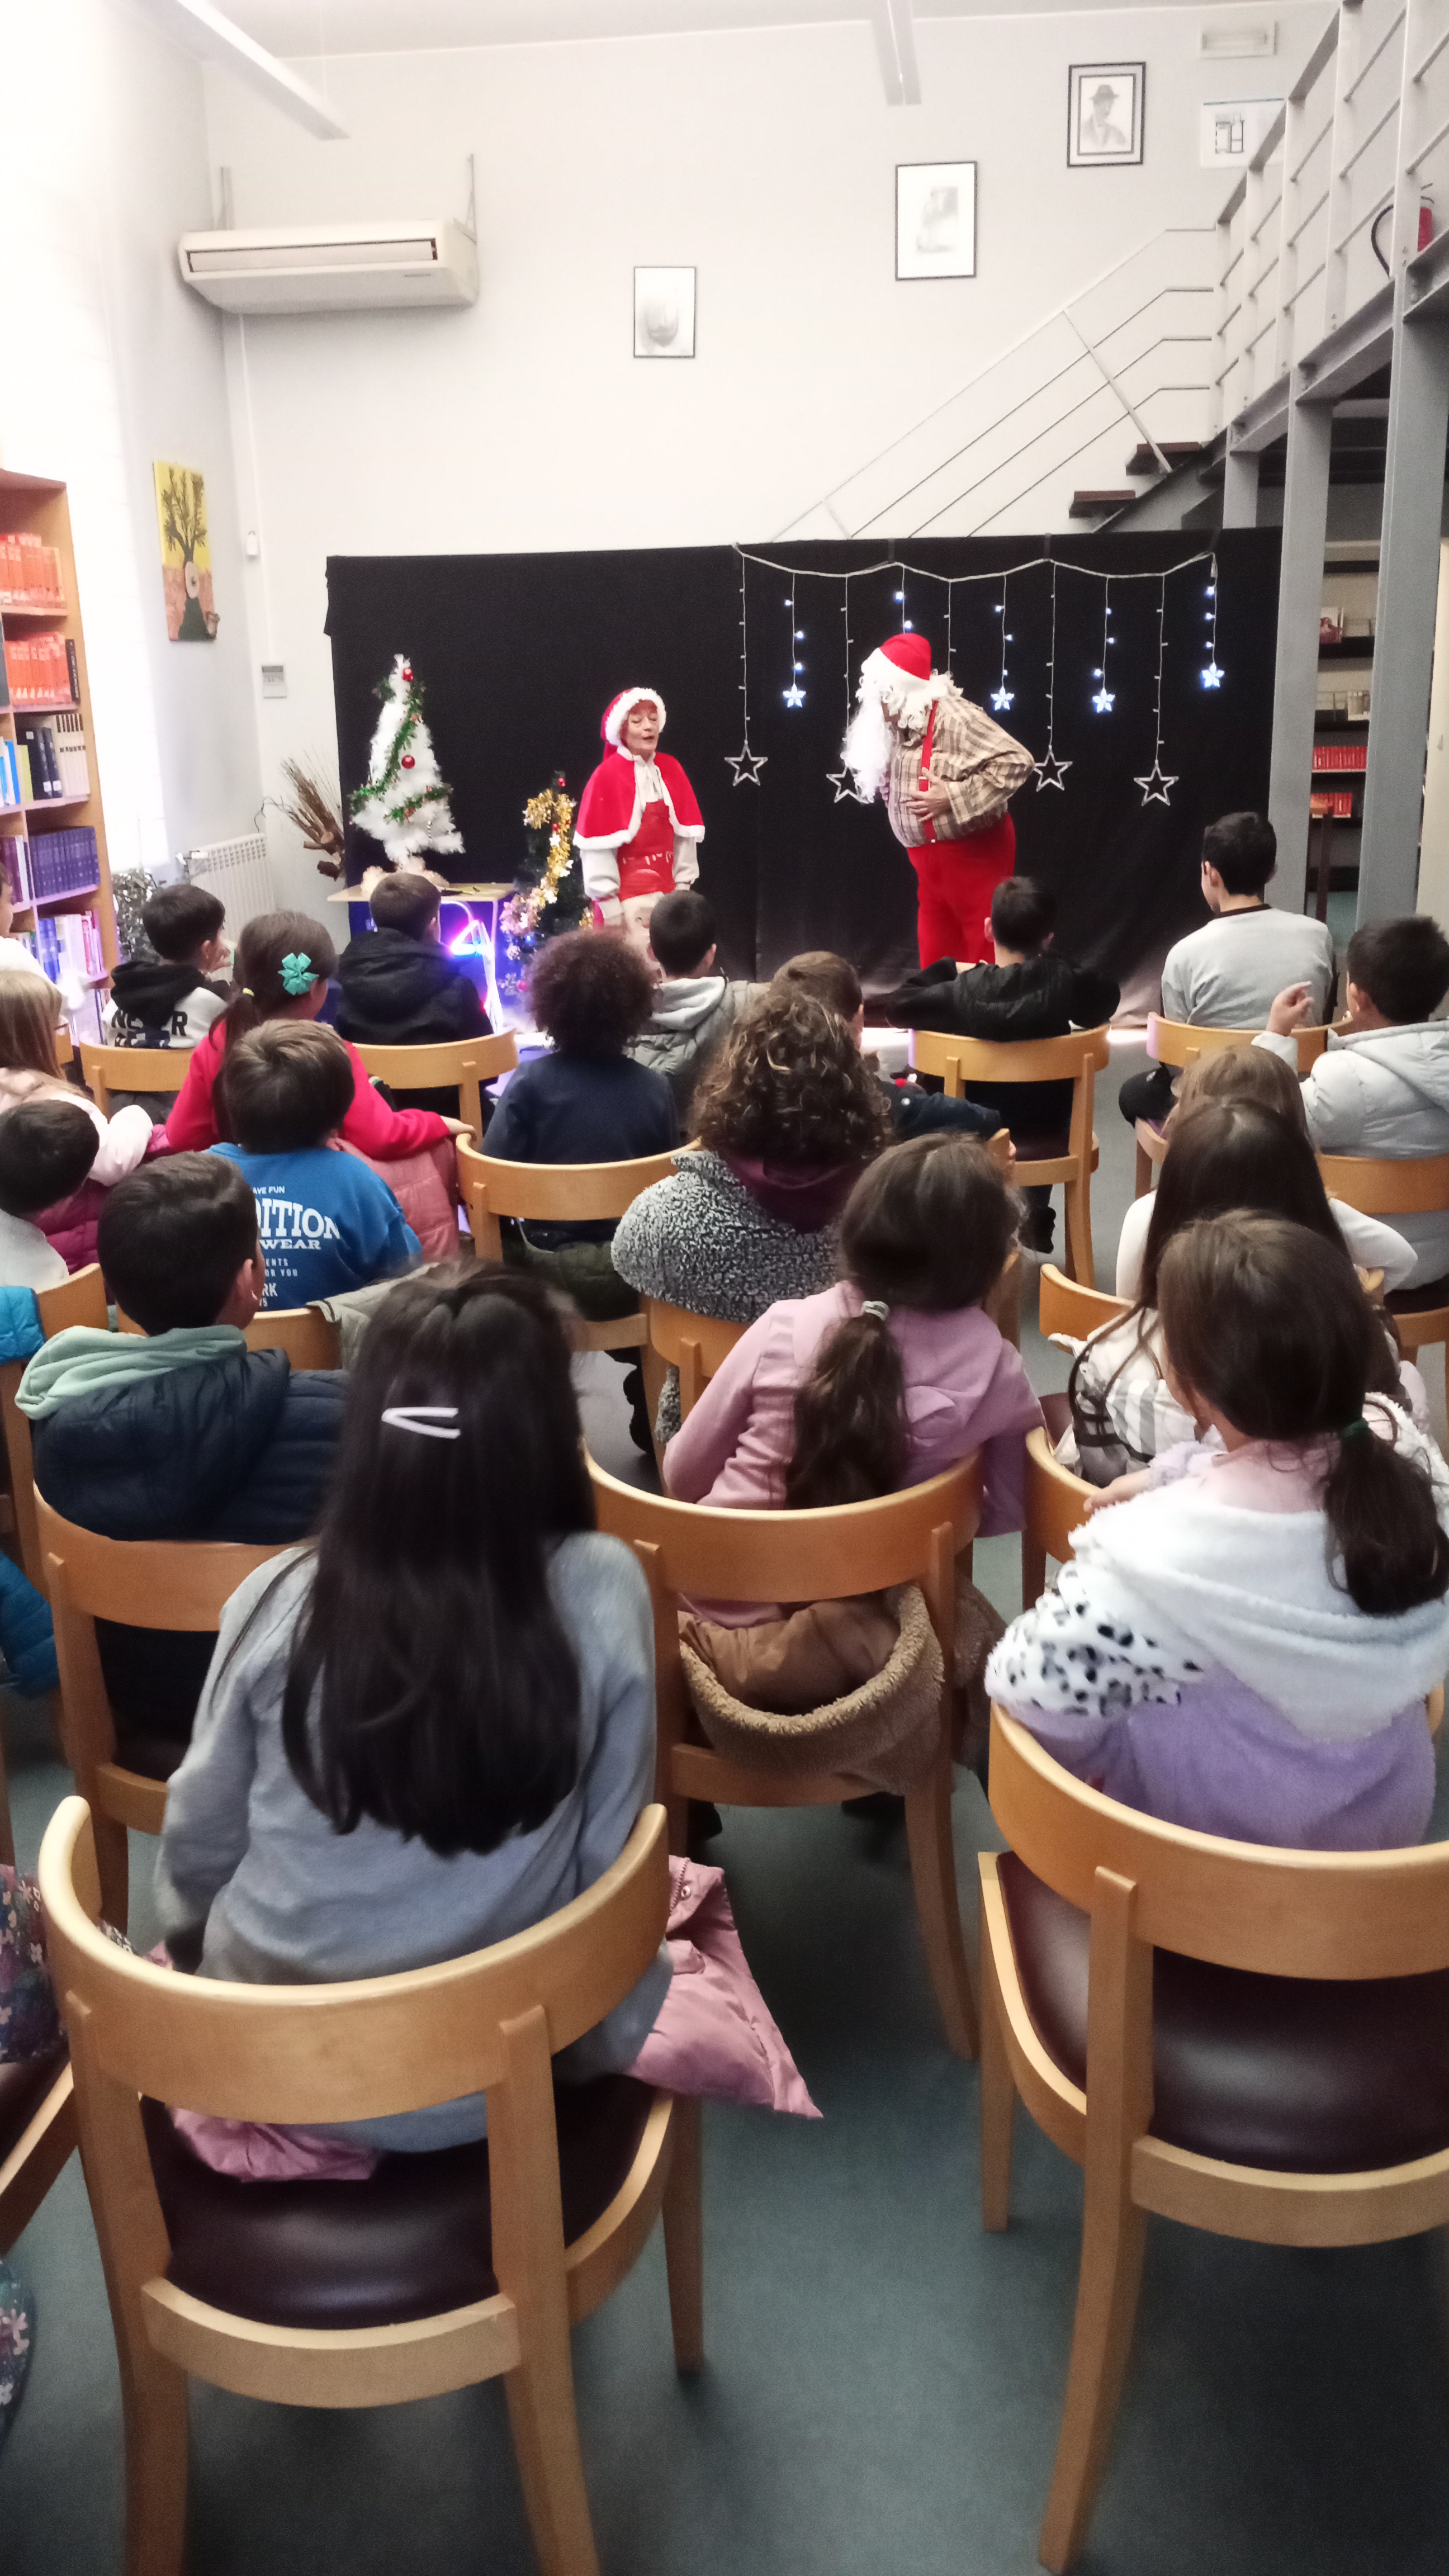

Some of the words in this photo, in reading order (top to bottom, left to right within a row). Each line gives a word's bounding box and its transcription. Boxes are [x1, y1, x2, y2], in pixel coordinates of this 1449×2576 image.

[253, 1186, 266, 1195] AVE
[268, 1186, 285, 1194] FUN
[266, 1258, 288, 1267] ENTS
[264, 1268, 276, 1277] OR
[280, 1268, 298, 1277] YOU
[262, 1282, 278, 1297] RK
